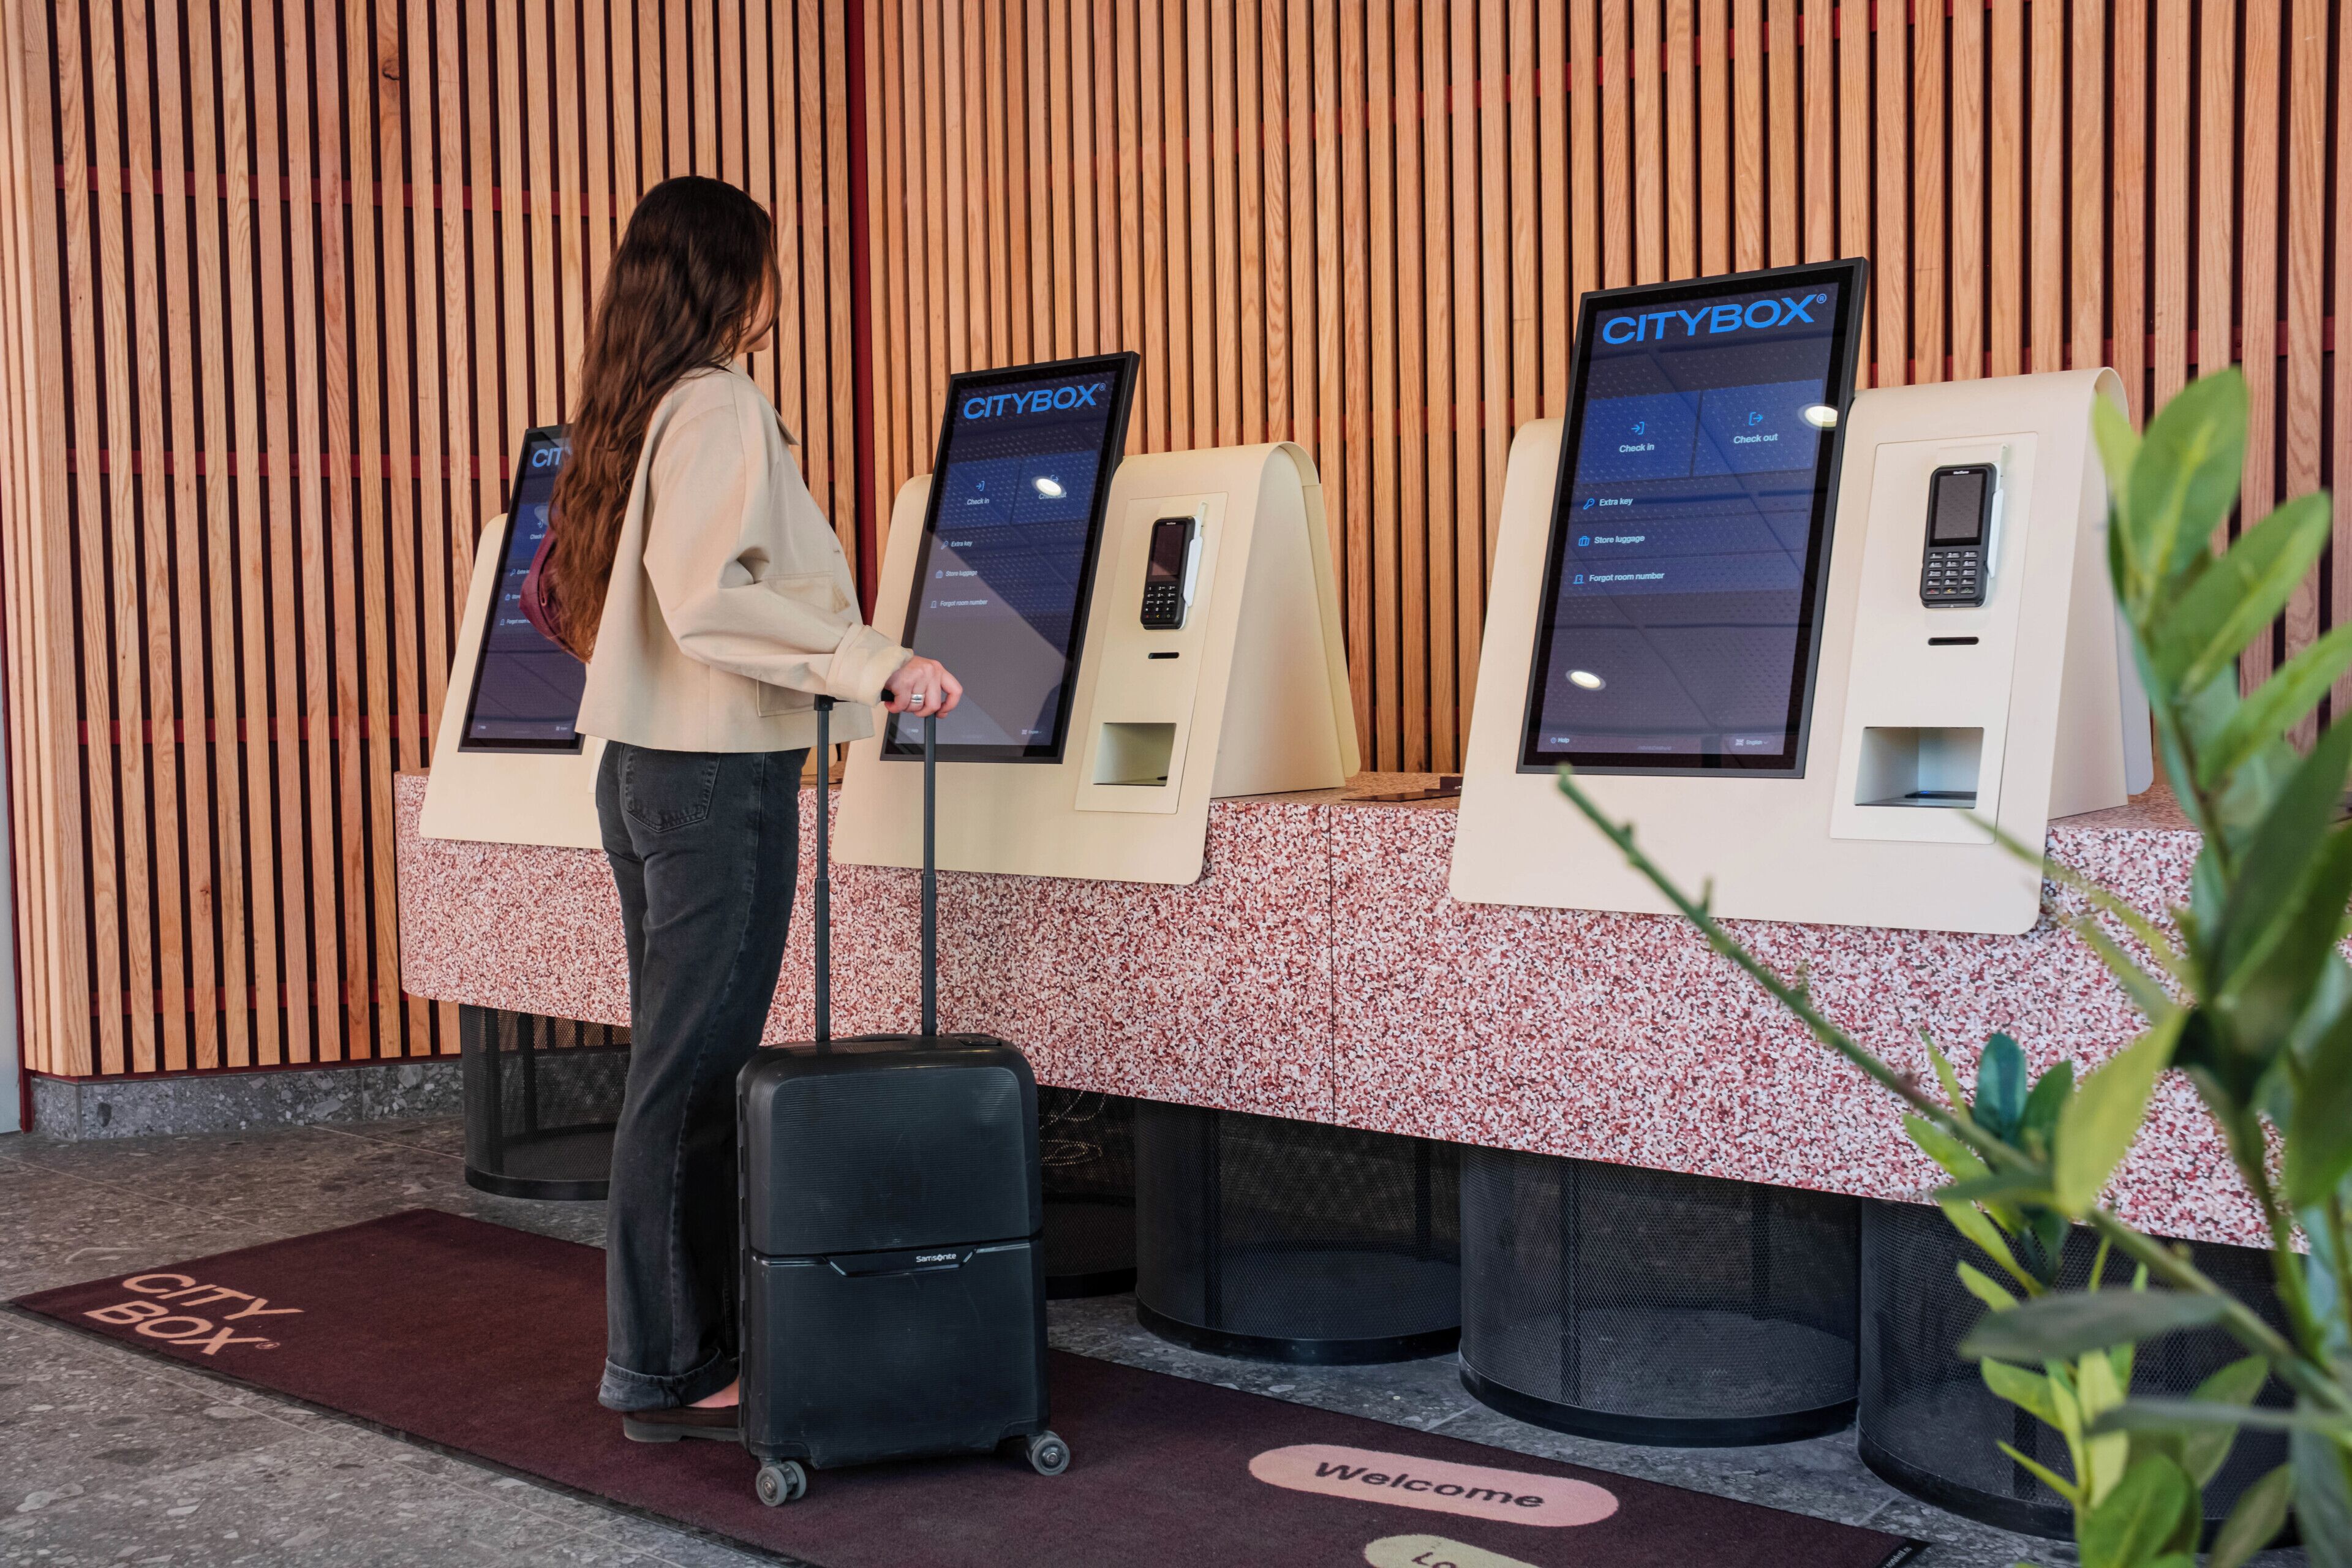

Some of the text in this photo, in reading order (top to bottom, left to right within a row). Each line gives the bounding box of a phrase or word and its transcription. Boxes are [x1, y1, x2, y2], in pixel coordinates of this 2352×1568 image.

[1733, 433, 1779, 444] Check out
[1619, 443, 1646, 453] Check
[1619, 497, 1634, 506] key
[1615, 535, 1645, 544] luggage
[1589, 574, 1614, 582] Forgot
[1635, 572, 1665, 581] number
[916, 1253, 957, 1263] Samsonite
[123, 1273, 305, 1321] CITY
[1314, 1461, 1544, 1508] Welcome
